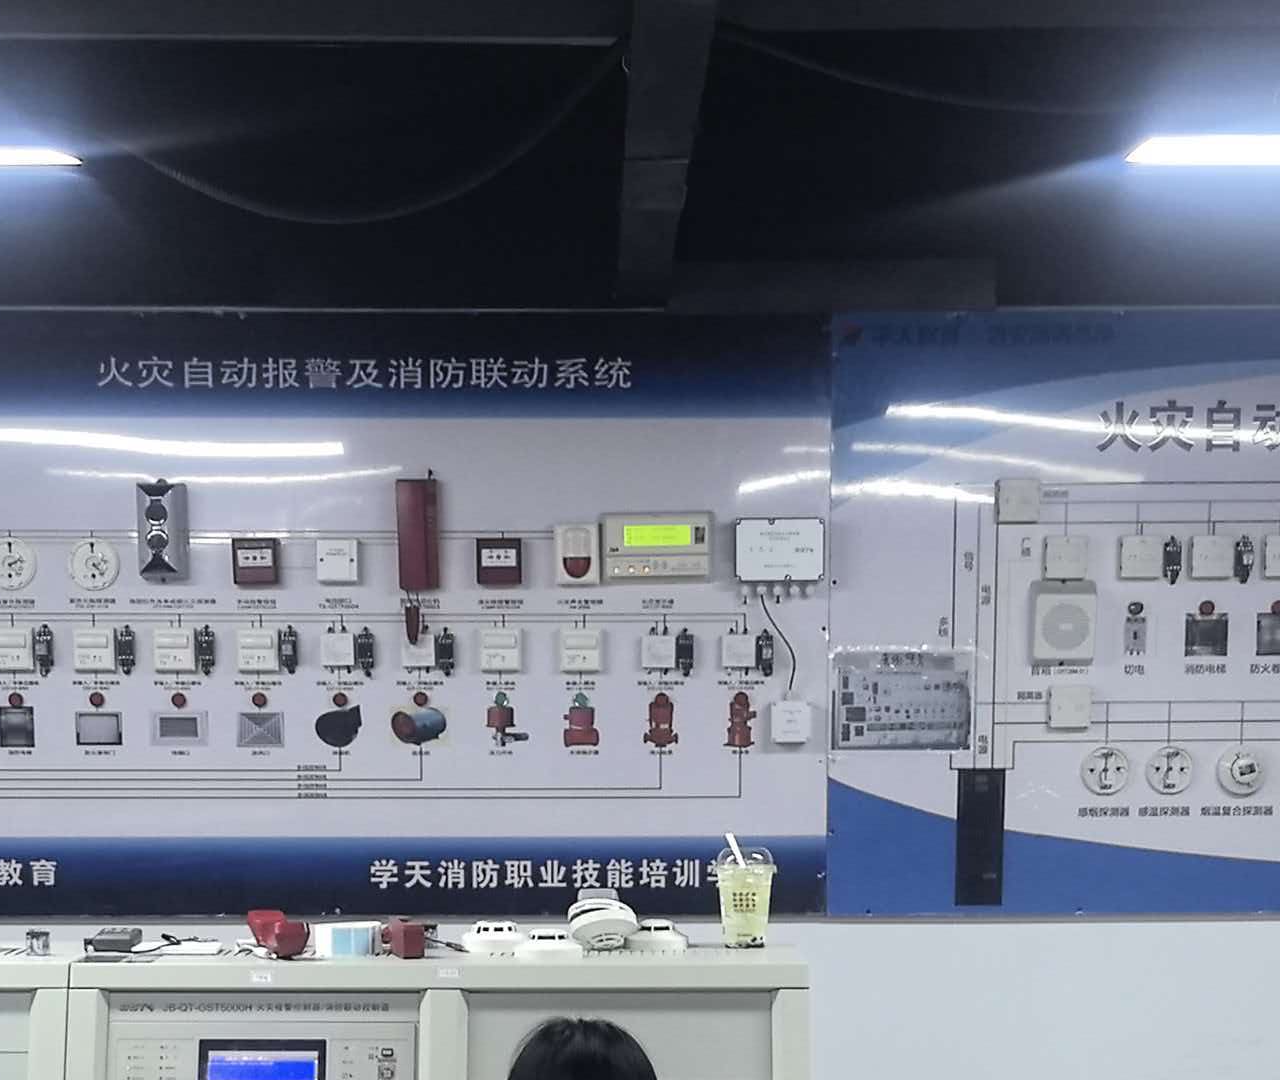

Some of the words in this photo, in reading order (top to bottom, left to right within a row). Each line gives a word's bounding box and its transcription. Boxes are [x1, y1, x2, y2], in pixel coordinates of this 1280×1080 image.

[98, 356, 632, 390] 火灾自动报警及消防联动系统
